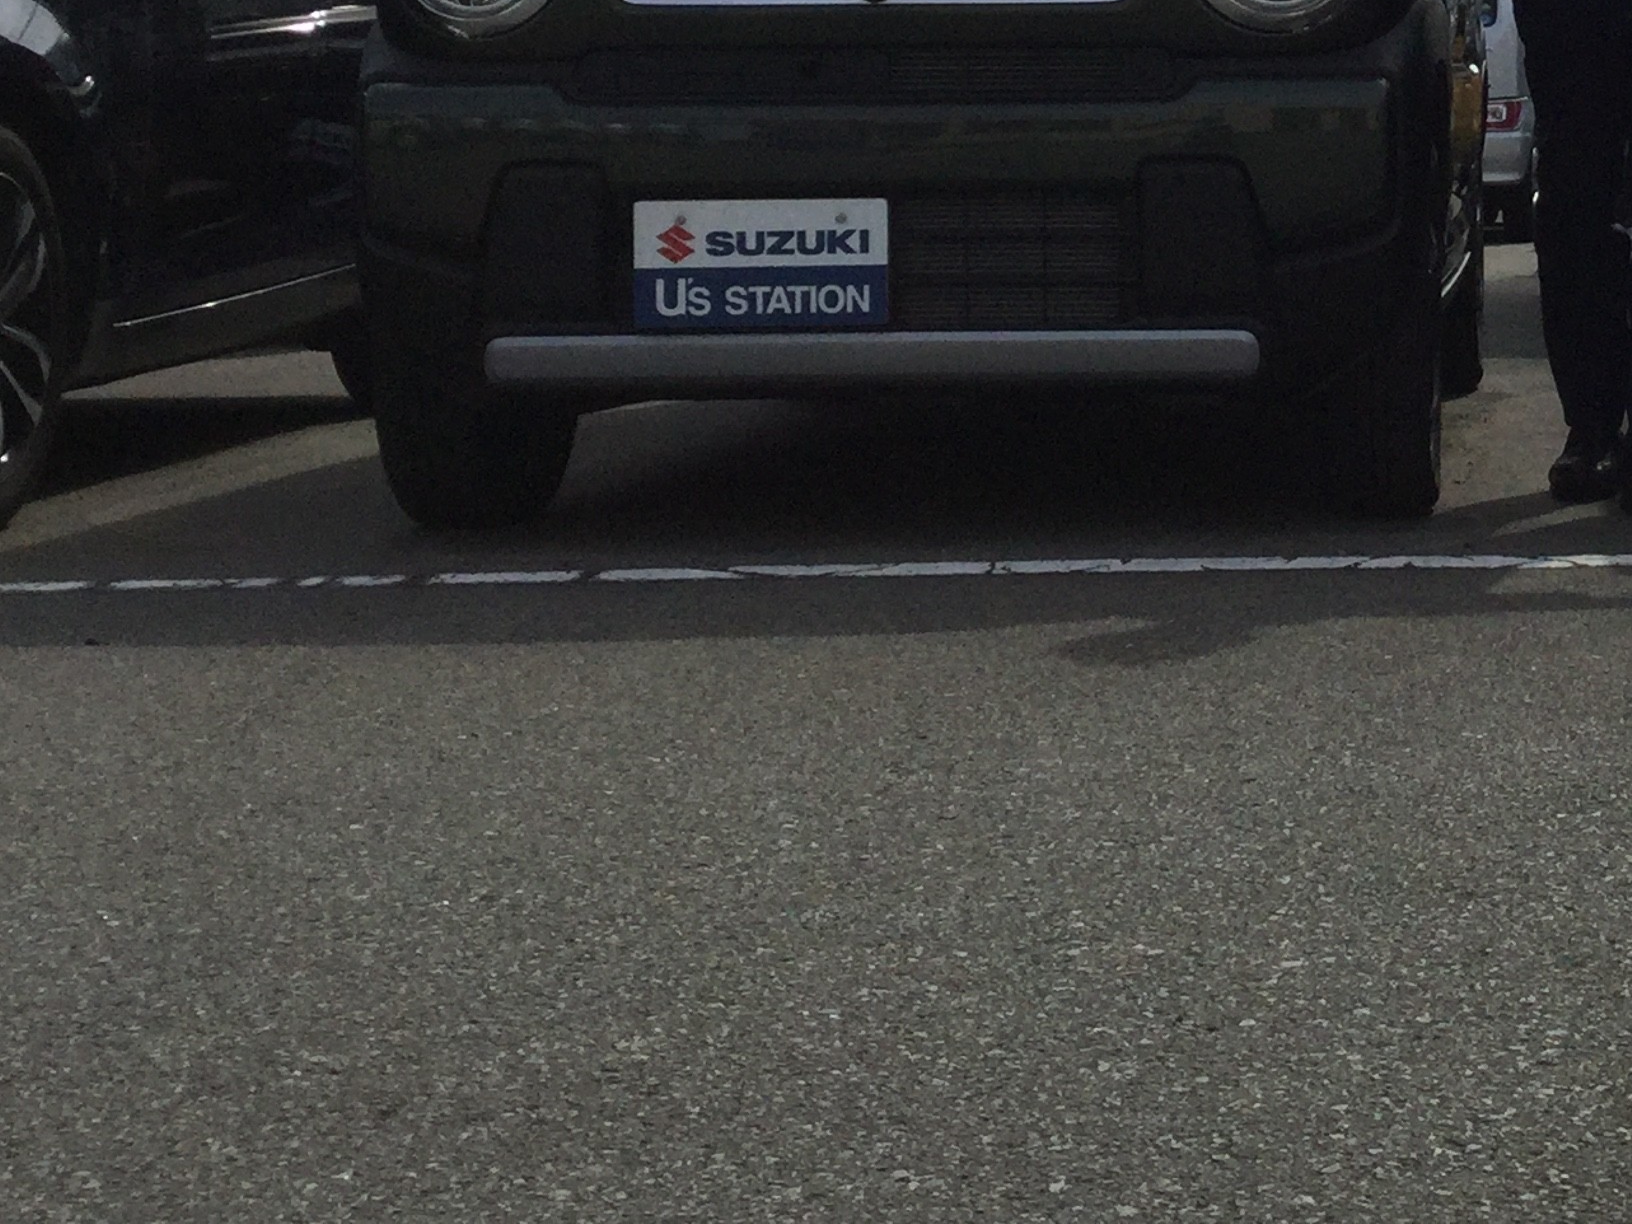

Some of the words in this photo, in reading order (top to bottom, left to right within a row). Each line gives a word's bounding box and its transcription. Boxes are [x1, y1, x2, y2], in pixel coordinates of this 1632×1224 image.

[705, 229, 870, 257] SUZUKI
[655, 277, 712, 317] U's
[725, 284, 871, 316] STATION
